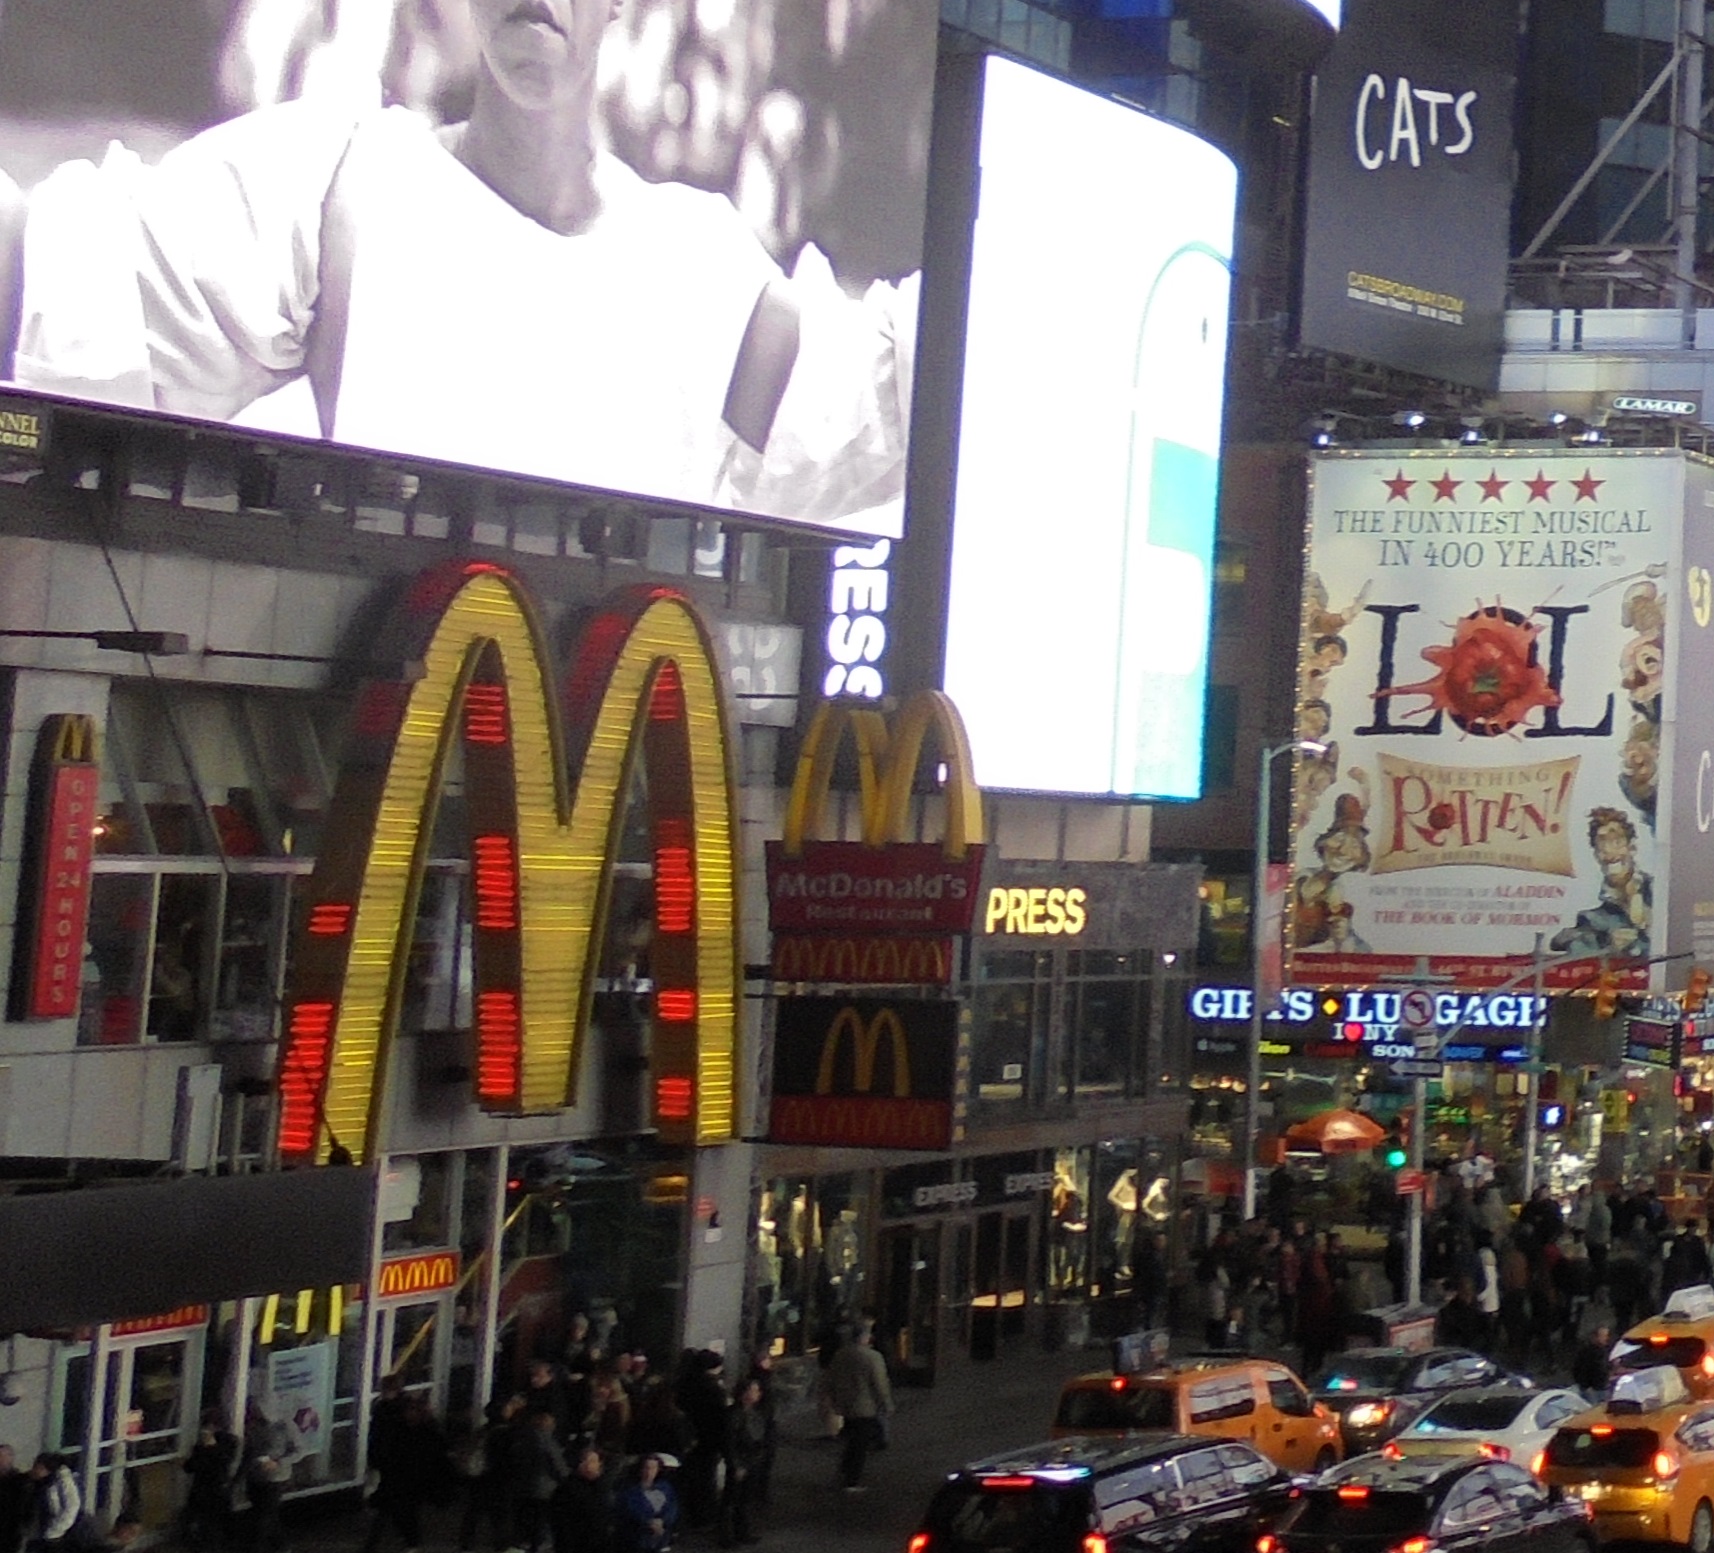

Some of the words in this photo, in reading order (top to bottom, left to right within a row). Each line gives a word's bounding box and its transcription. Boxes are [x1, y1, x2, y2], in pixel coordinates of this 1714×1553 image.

[1356, 74, 1477, 170] CATS
[1618, 397, 1689, 414] LAMAR
[1334, 509, 1386, 534] THE
[1391, 510, 1526, 535] FUNNIEST
[1532, 509, 1652, 535] MUSICAL
[1378, 539, 1418, 567] IN
[1425, 539, 1485, 569] 400
[62, 777, 86, 863] OPEN
[55, 871, 82, 890] 24
[776, 873, 967, 899] McDonald's
[985, 887, 1086, 934] PRESS
[1347, 992, 1546, 1028] LUGAGE
[1363, 1023, 1400, 1042] NY
[1372, 1044, 1416, 1059] SON
